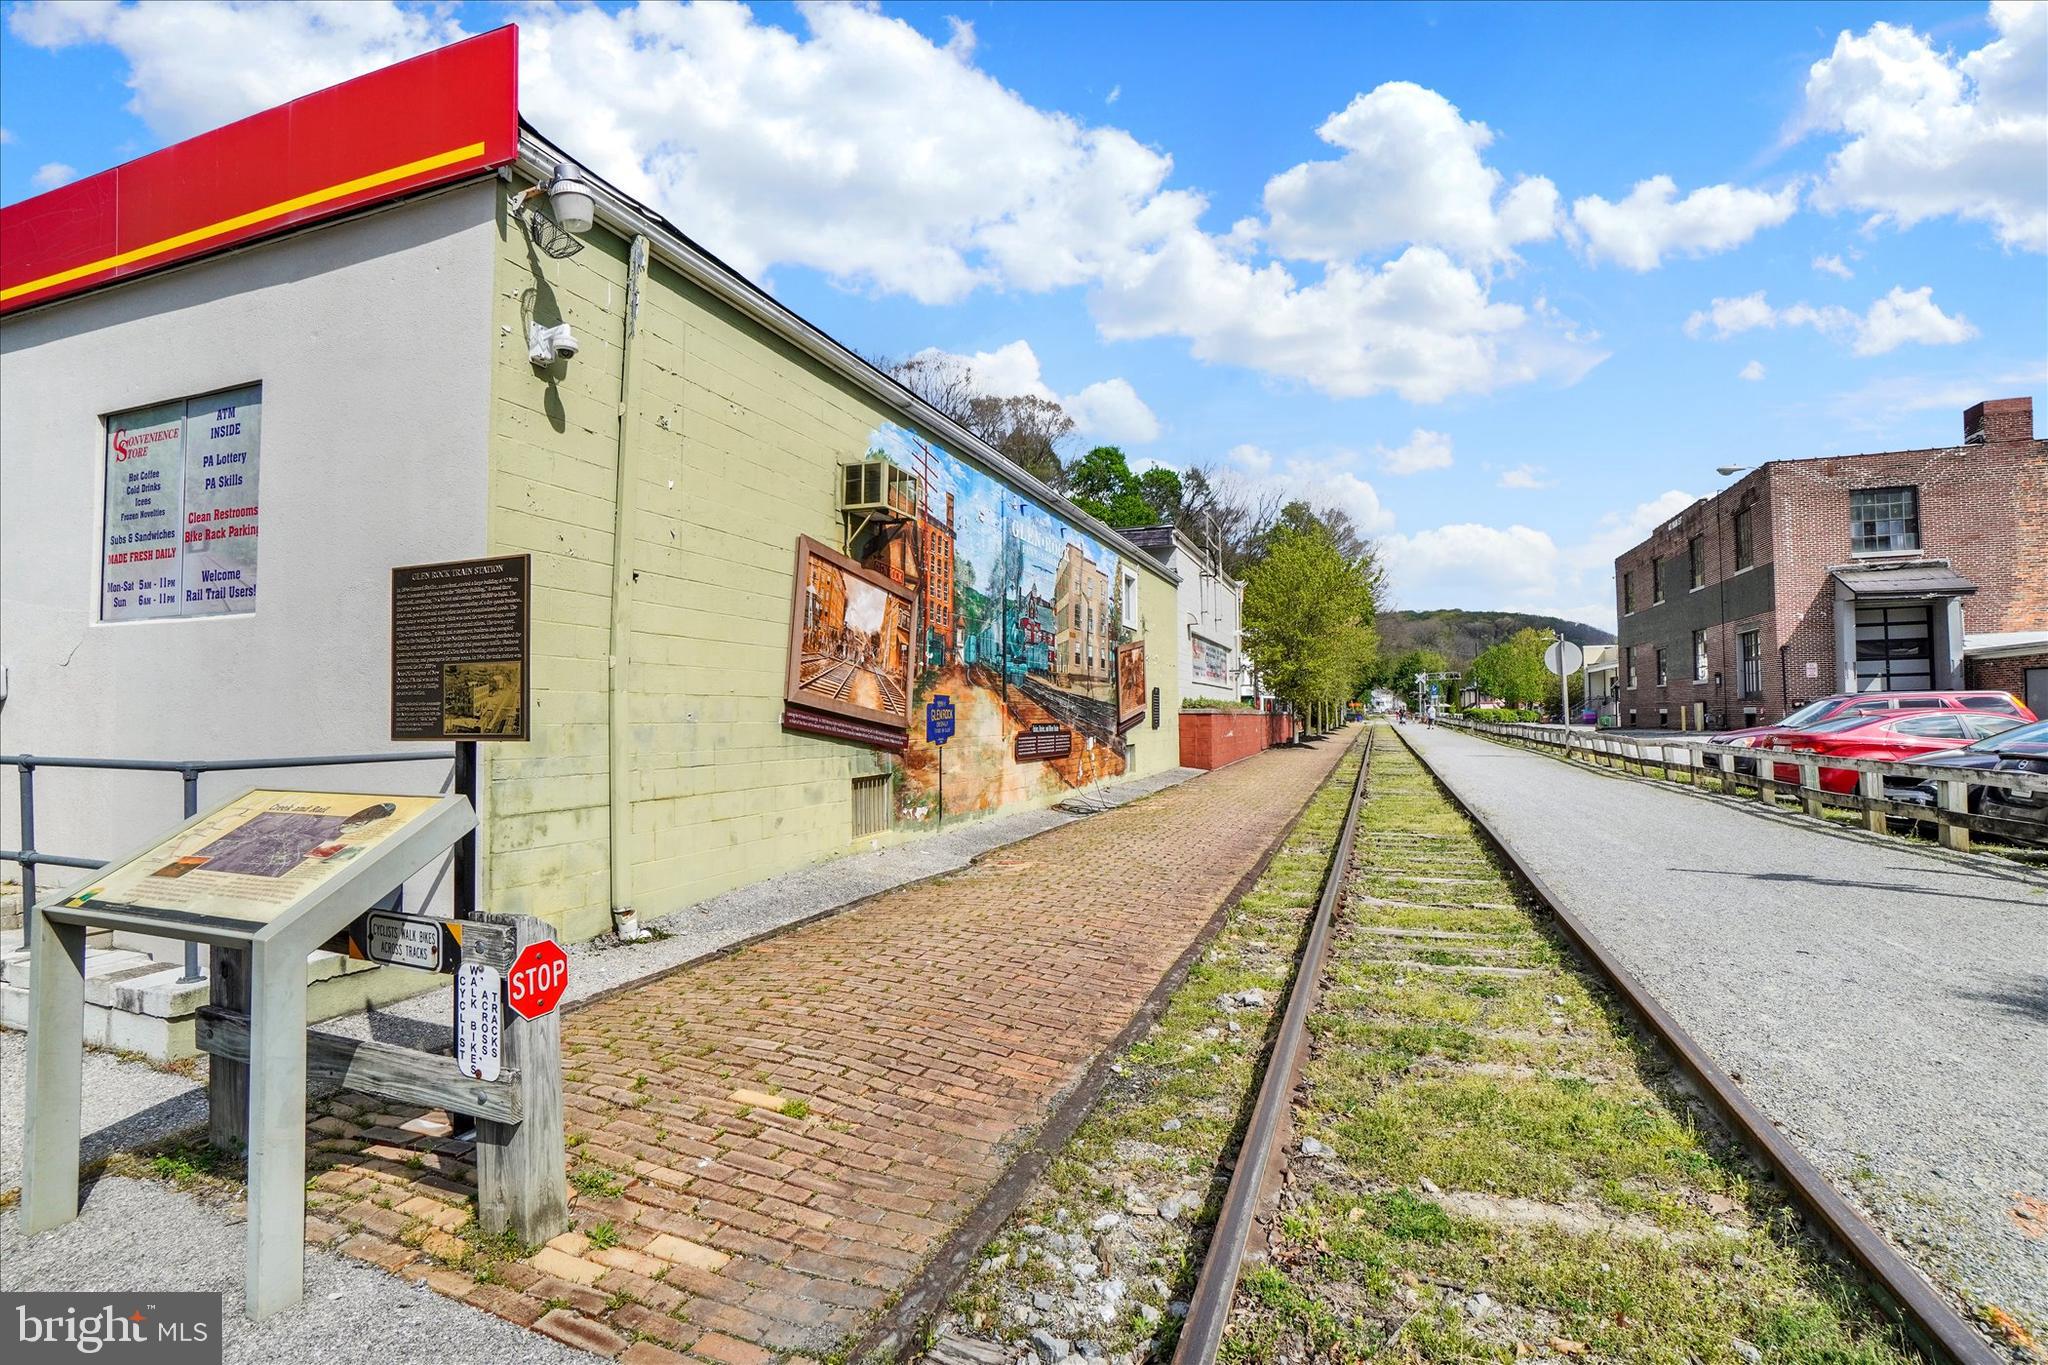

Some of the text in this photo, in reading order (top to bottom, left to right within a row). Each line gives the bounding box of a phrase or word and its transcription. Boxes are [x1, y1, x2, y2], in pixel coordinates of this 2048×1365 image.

[217, 406, 236, 421] ATM
[210, 423, 241, 439] INSIDE
[113, 428, 180, 452] CONVENIENCE
[116, 439, 148, 462] STORE
[203, 451, 247, 468] PA Lottery
[128, 470, 160, 482] Hot Coffee
[205, 474, 243, 490] PA Skills
[126, 482, 161, 495] Cold Drinks
[120, 508, 166, 521] Frozen Novelties
[188, 506, 258, 524] Clean Restrooms
[110, 529, 176, 546] Subs & Sandwiches
[184, 530, 203, 543] Bike
[204, 527, 226, 540] Rack
[108, 547, 177, 565] MADE FRESH DAILY
[202, 569, 241, 582] Welcome
[412, 564, 504, 581] GLEN ROCK TRAIN STATION
[107, 581, 135, 592] Mon-Sat
[186, 584, 256, 602] Rail Trail Users!
[114, 597, 127, 608] Sun
[373, 923, 436, 945] CYCLISTS WALK BIKES
[381, 940, 428, 960] ACROSS TRACKS
[470, 965, 479, 1009] WALK
[512, 959, 565, 1000] STOP
